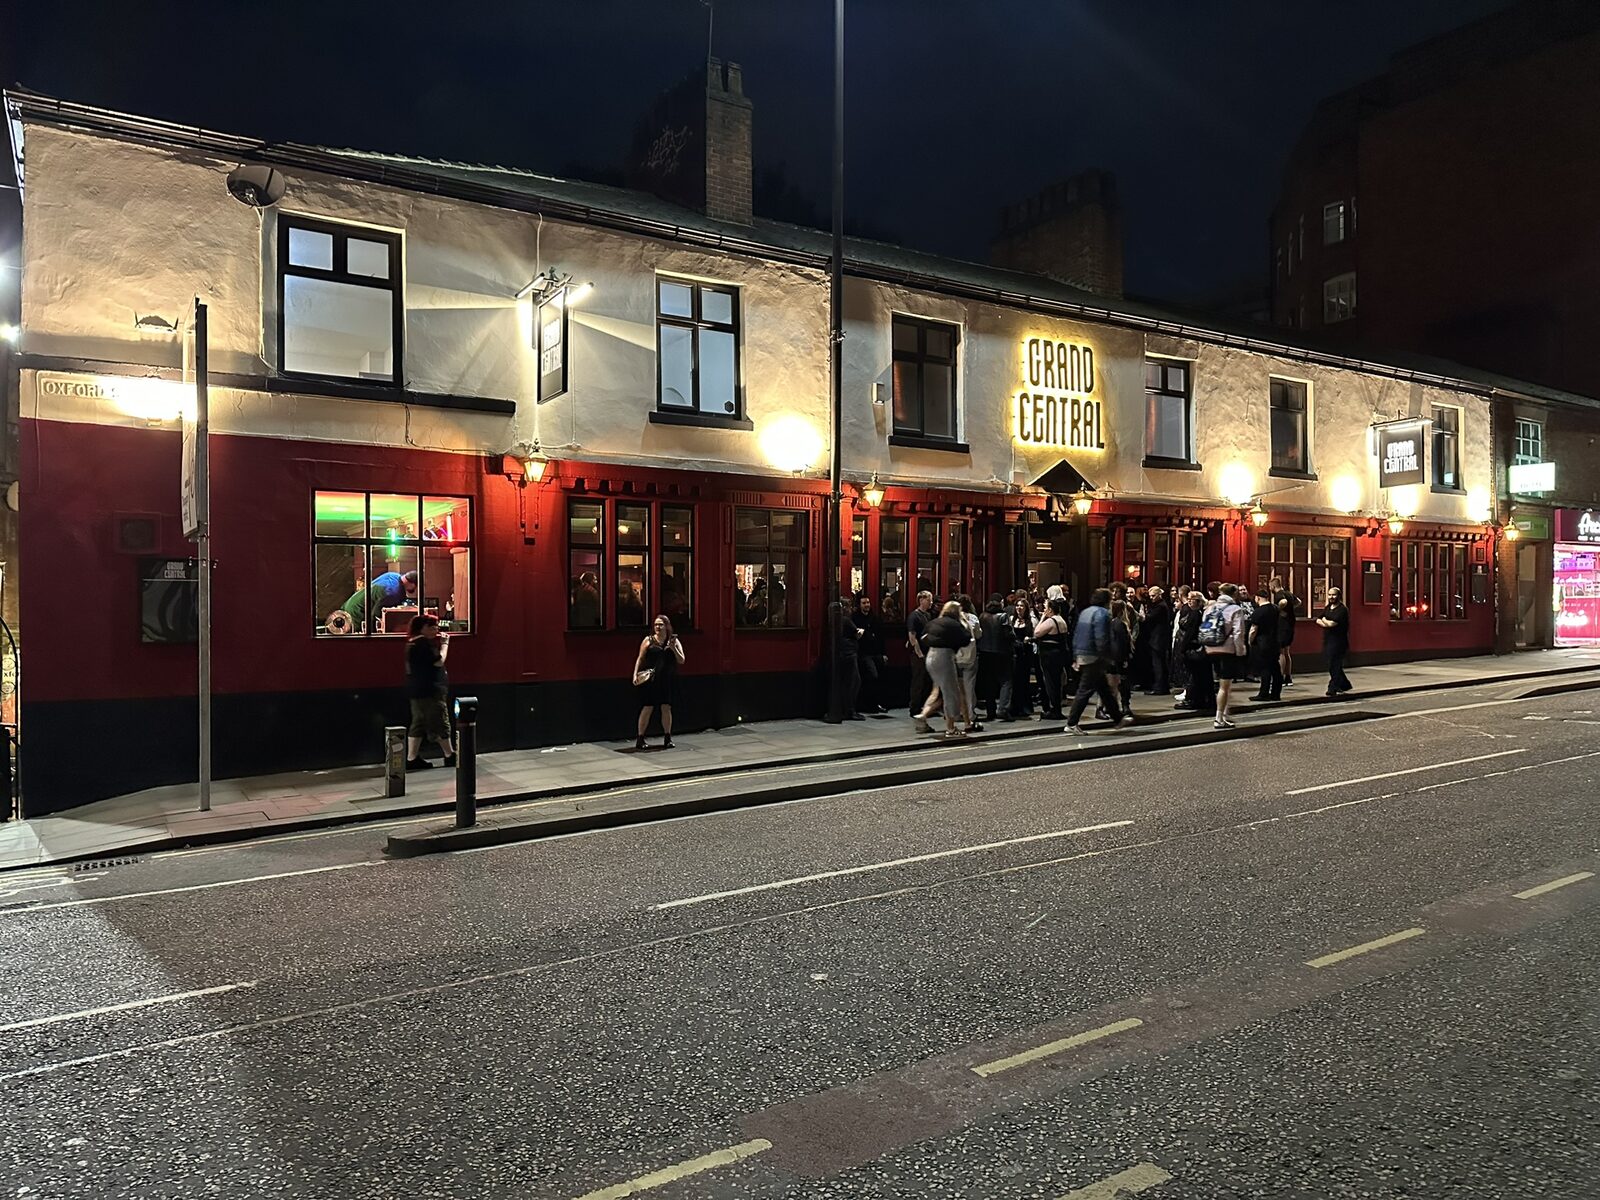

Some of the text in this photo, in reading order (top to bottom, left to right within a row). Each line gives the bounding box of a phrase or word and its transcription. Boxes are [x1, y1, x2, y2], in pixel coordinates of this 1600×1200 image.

[1029, 338, 1094, 393] GRAND
[1020, 392, 1104, 449] CENTRAL
[1383, 454, 1419, 474] CENTRAL
